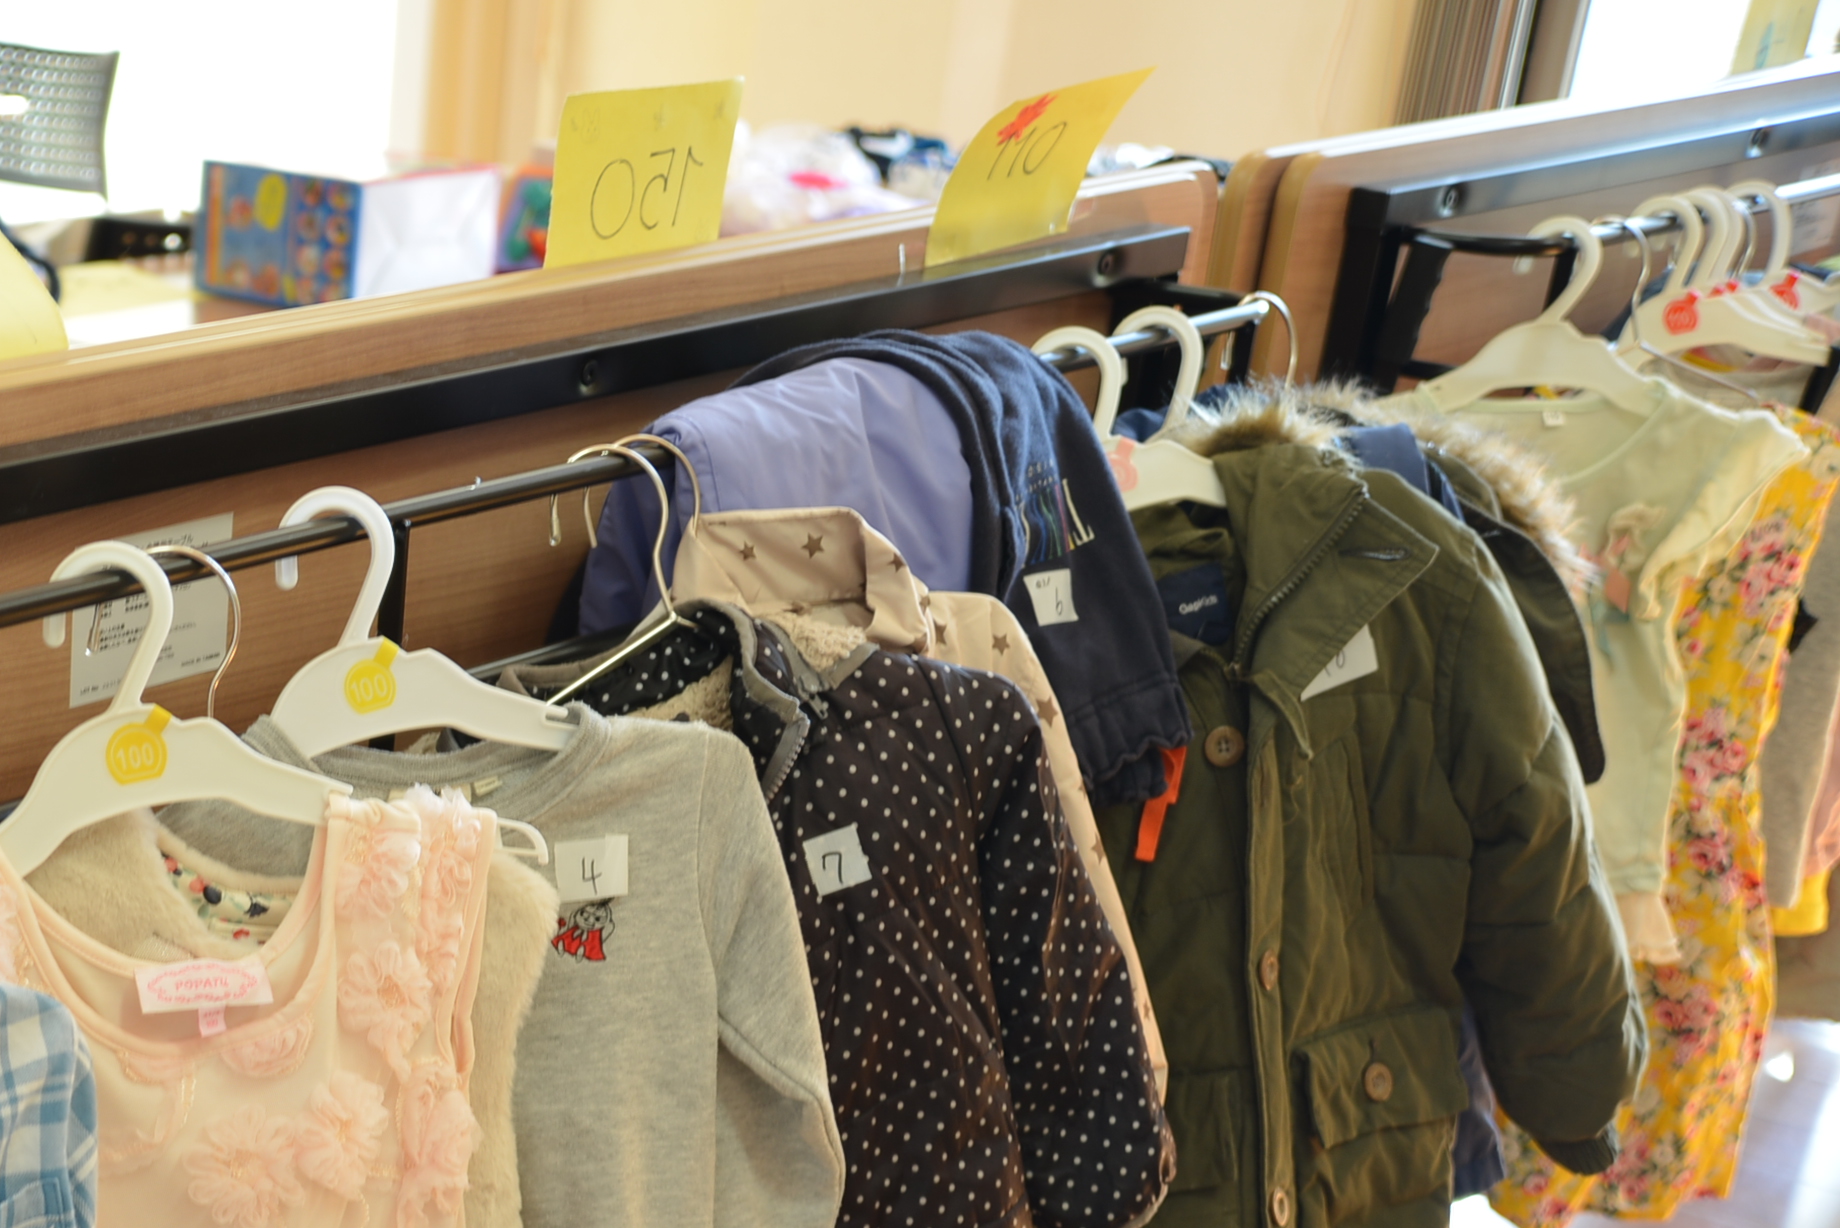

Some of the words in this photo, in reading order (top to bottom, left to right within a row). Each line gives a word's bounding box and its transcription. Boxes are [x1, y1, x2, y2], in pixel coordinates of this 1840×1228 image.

[350, 673, 388, 704] 100
[115, 742, 155, 772] 100
[581, 856, 602, 896] 4
[822, 851, 843, 885] 7
